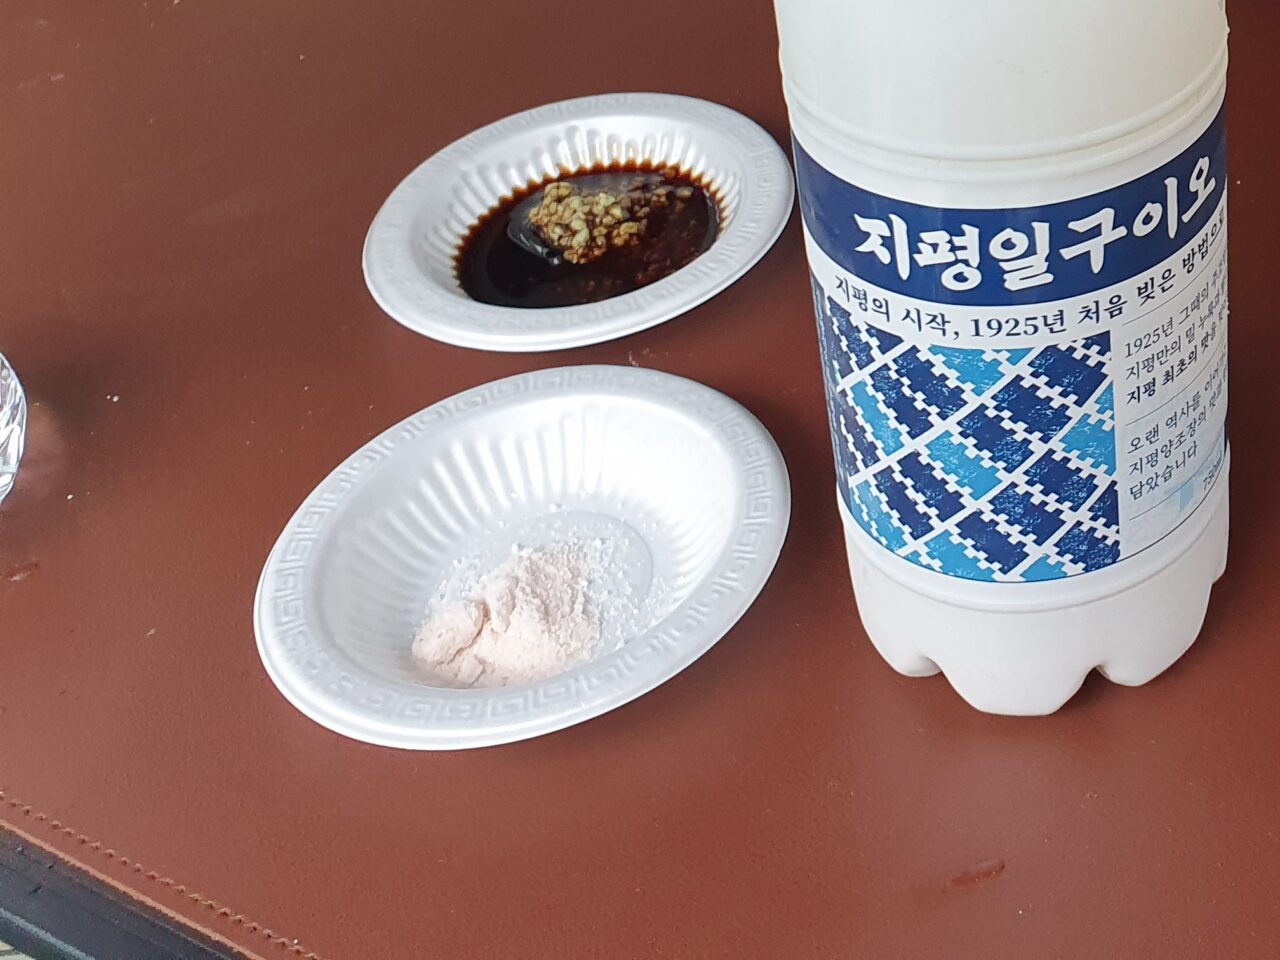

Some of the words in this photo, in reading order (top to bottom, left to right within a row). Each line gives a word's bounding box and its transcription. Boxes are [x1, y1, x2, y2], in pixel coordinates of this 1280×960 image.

[854, 155, 1218, 292] 지평일구이오
[835, 275, 891, 323] 지평의
[902, 306, 959, 340] 시작,
[970, 309, 1067, 338] 1925년
[1077, 294, 1128, 325] 처음
[1136, 268, 1176, 307] 빚은
[1125, 316, 1173, 358] 1925년
[1178, 282, 1209, 326] 그때의
[1126, 335, 1181, 380] 지평만의
[1185, 322, 1195, 344] 밀
[1126, 377, 1157, 405] 지평
[1162, 345, 1197, 386] 최초의
[1128, 424, 1159, 454] 오랜
[1166, 391, 1202, 430] 역사를
[1129, 408, 1207, 476] 지평양조장의
[1129, 441, 1198, 501] 담았습니다
